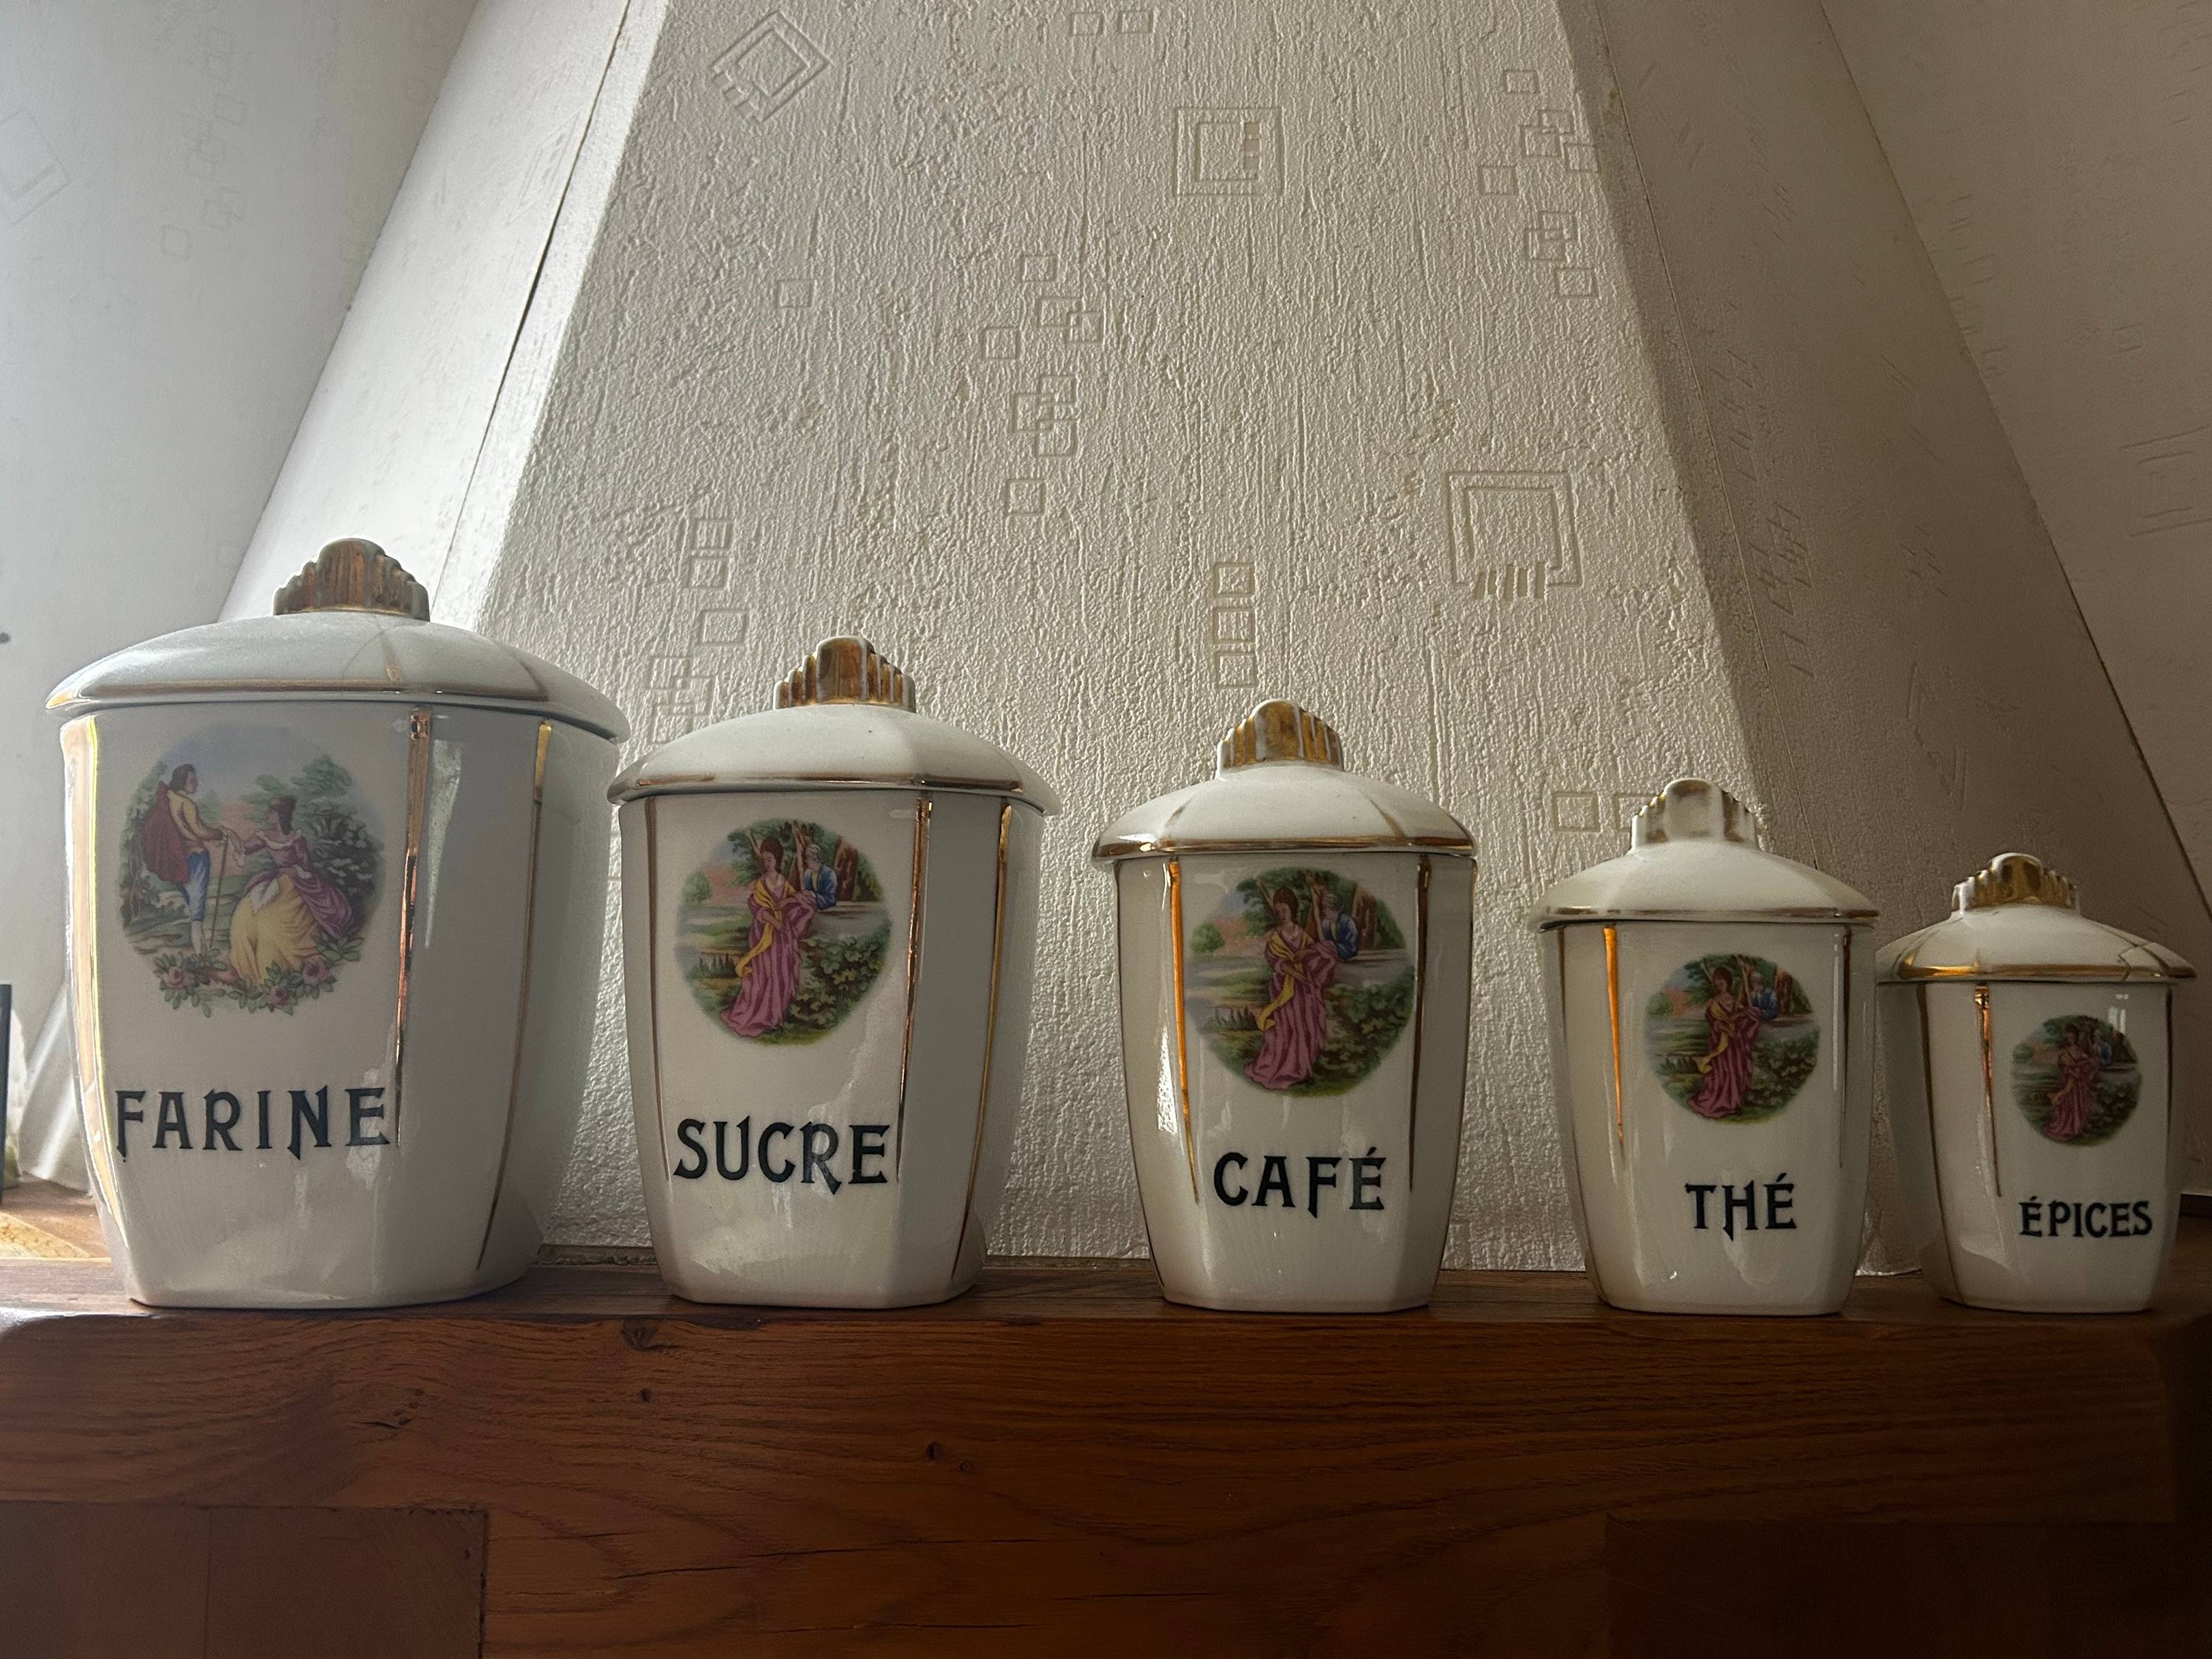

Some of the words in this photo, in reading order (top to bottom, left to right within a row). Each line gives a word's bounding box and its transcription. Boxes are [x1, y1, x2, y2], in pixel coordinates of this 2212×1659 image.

[116, 1085, 391, 1161] FARINE
[672, 1115, 891, 1195] SUCRE
[1213, 1146, 1387, 1219] CAFÉ
[1684, 1172, 1798, 1242] THÉ
[2018, 1195, 2154, 1239] ÉPICES
